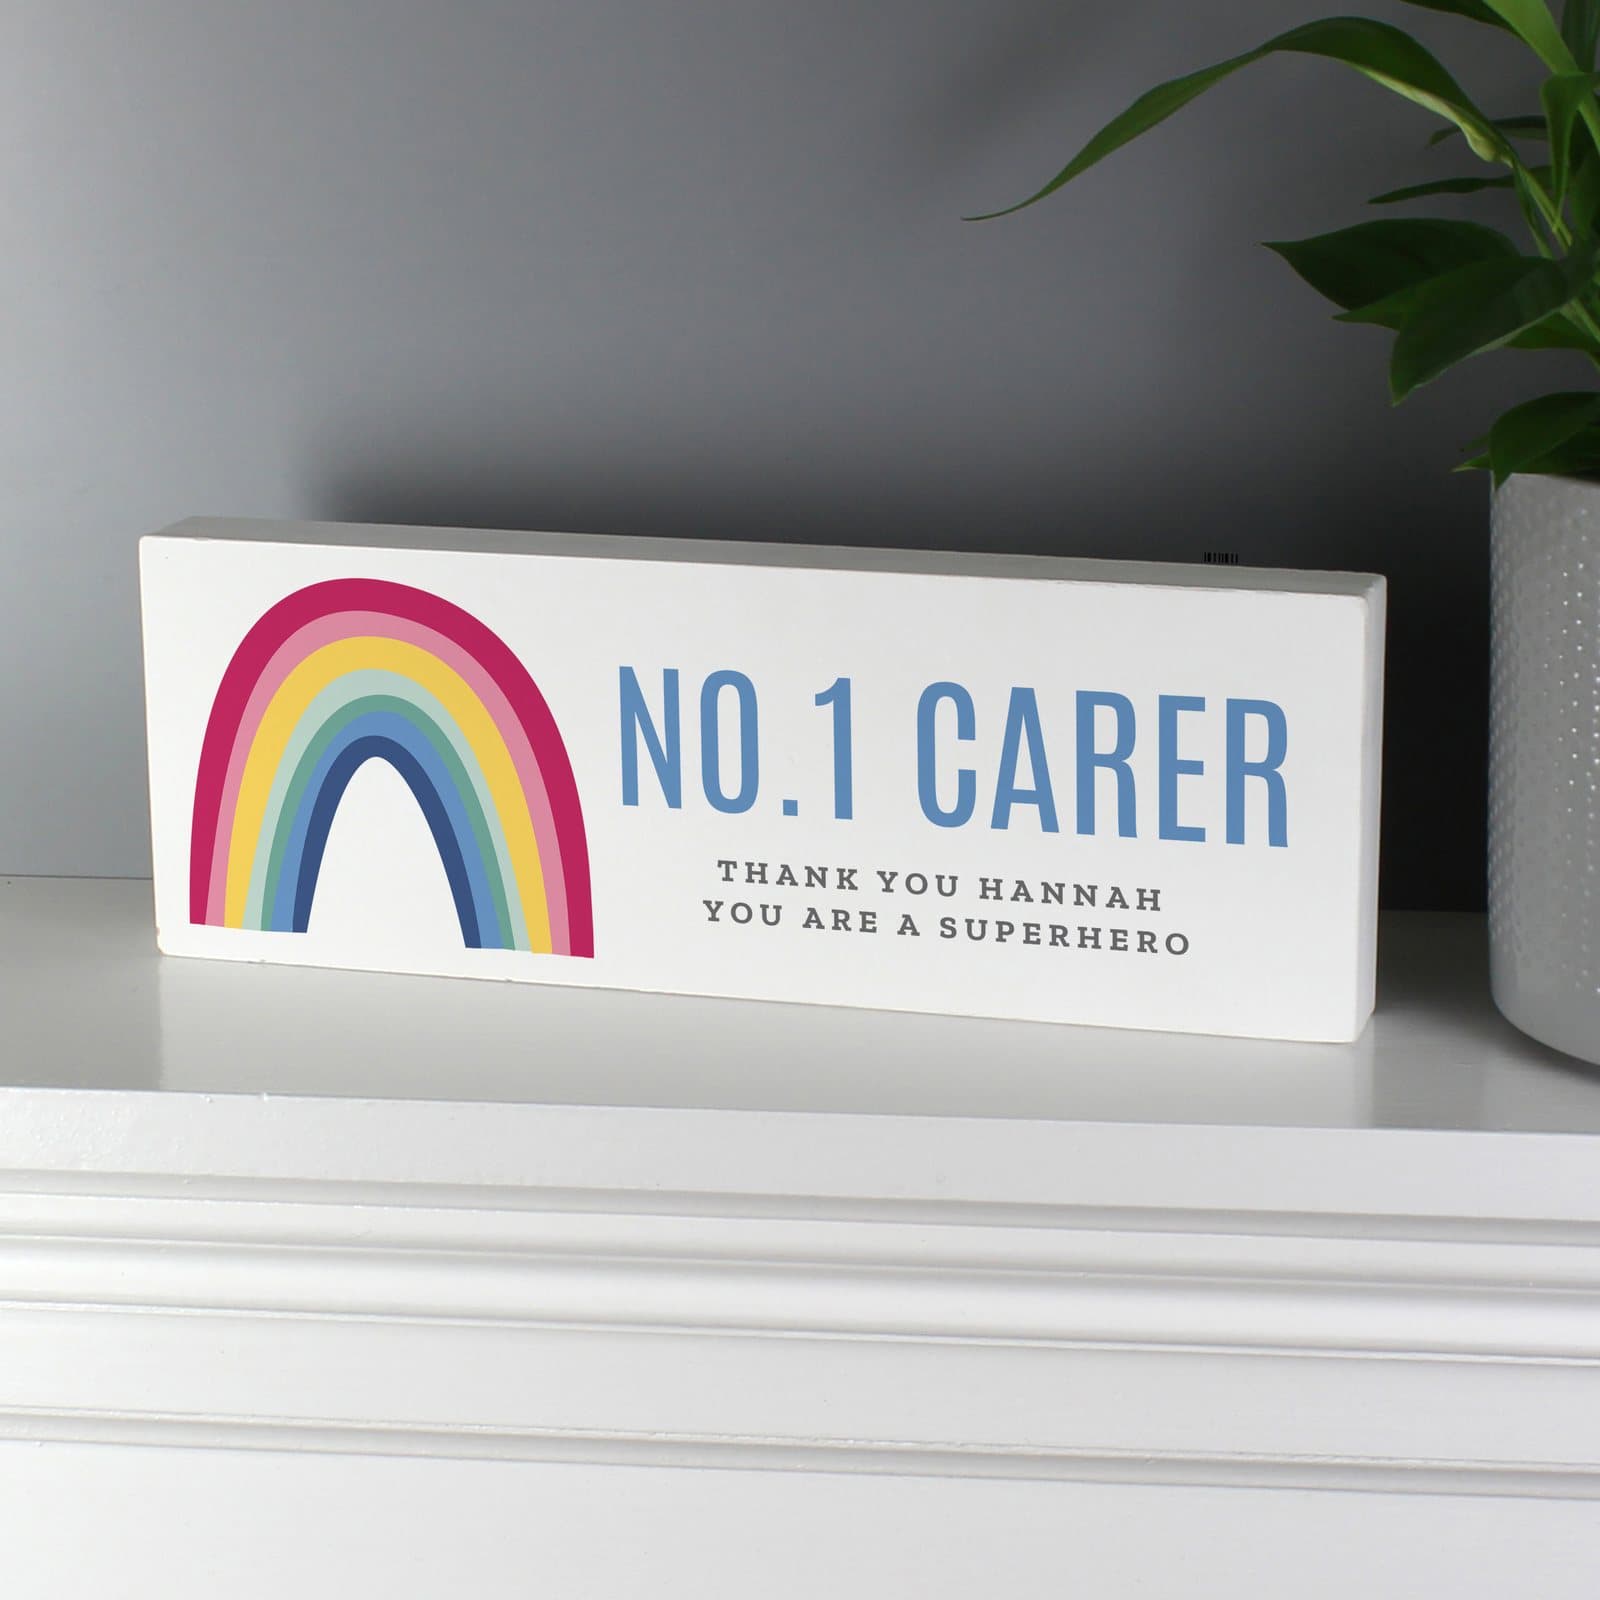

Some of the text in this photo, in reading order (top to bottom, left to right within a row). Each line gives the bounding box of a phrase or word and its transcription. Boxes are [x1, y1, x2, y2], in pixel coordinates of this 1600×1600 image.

[619, 667, 1288, 847] NO.1 CARER
[718, 860, 1162, 911] THANK YOU HANNAH
[703, 900, 1190, 955] YOU ARE A SUPERHERO
